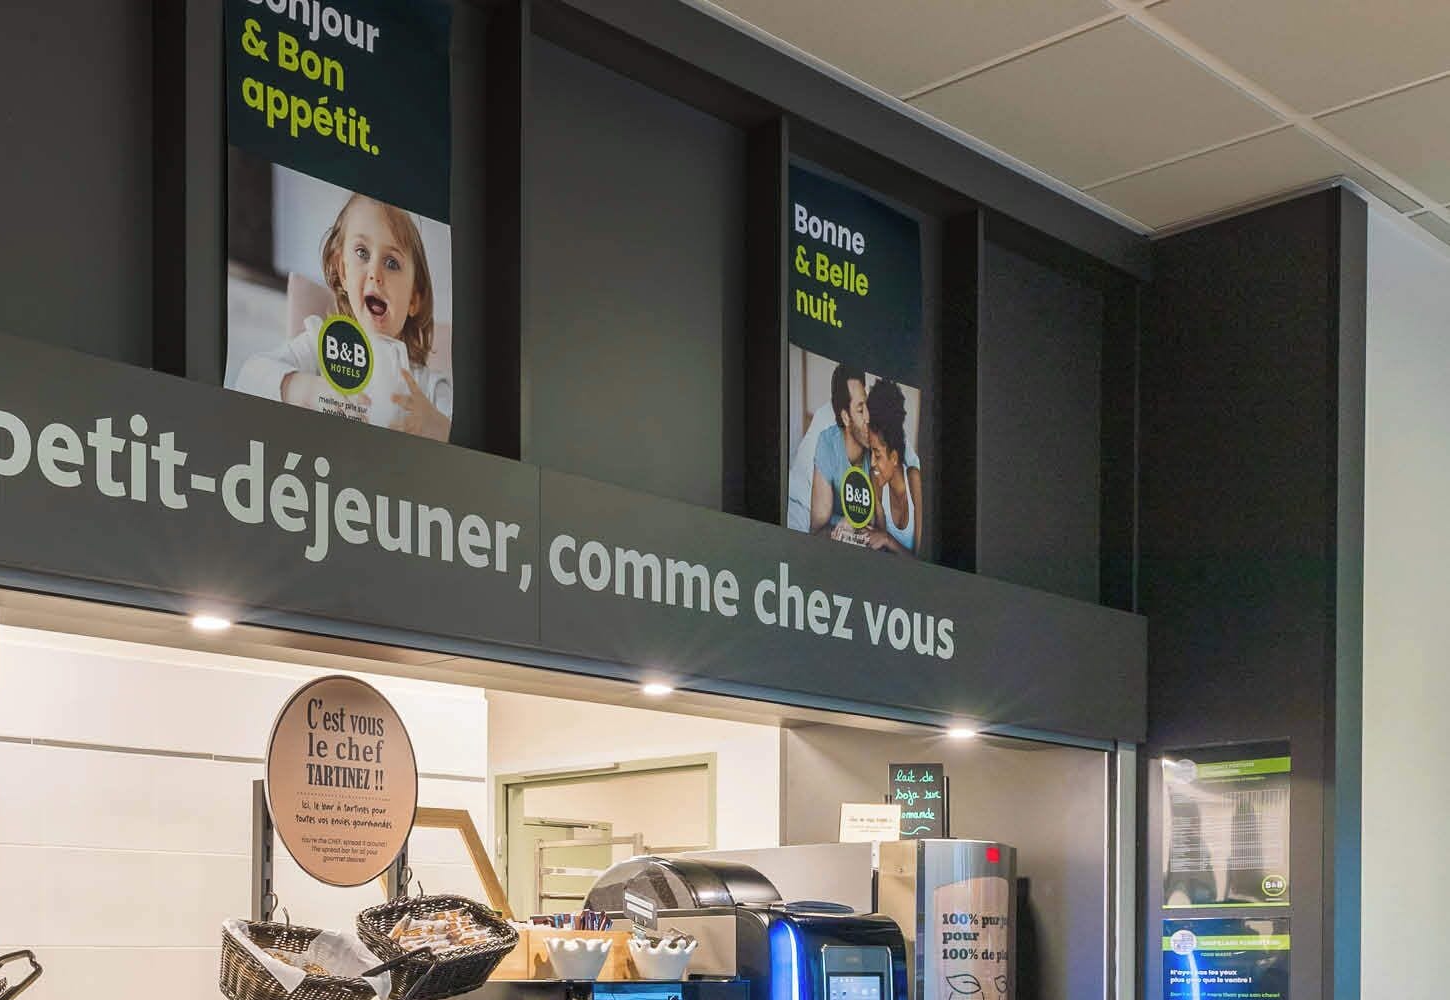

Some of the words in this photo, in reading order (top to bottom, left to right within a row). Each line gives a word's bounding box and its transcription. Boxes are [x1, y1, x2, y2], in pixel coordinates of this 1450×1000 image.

[247, 0, 379, 53] njour
[242, 18, 269, 62] &
[278, 31, 345, 92] Bon
[242, 76, 380, 156] appétit.
[794, 203, 865, 255] Bonne
[795, 245, 811, 278] &
[816, 252, 869, 297] Belle
[796, 288, 842, 328] nuit.
[326, 335, 367, 368] B&B
[330, 363, 361, 378] HOTELS
[846, 483, 870, 506] B&B
[549, 533, 740, 616] comme
[754, 562, 853, 640] chez
[863, 601, 955, 660] vous
[307, 699, 346, 733] C'est
[350, 714, 384, 737] vous
[308, 732, 328, 758] le
[336, 737, 384, 763] chef
[306, 763, 370, 791] TARTINEZ
[895, 769, 916, 782] lait
[919, 770, 934, 782] de
[895, 787, 920, 806] soja
[942, 913, 979, 925] 100%
[982, 916, 999, 928] pur
[942, 932, 979, 944] pour
[942, 948, 979, 960] 100%
[982, 949, 995, 960] de
[1170, 969, 1192, 978] N'aye
